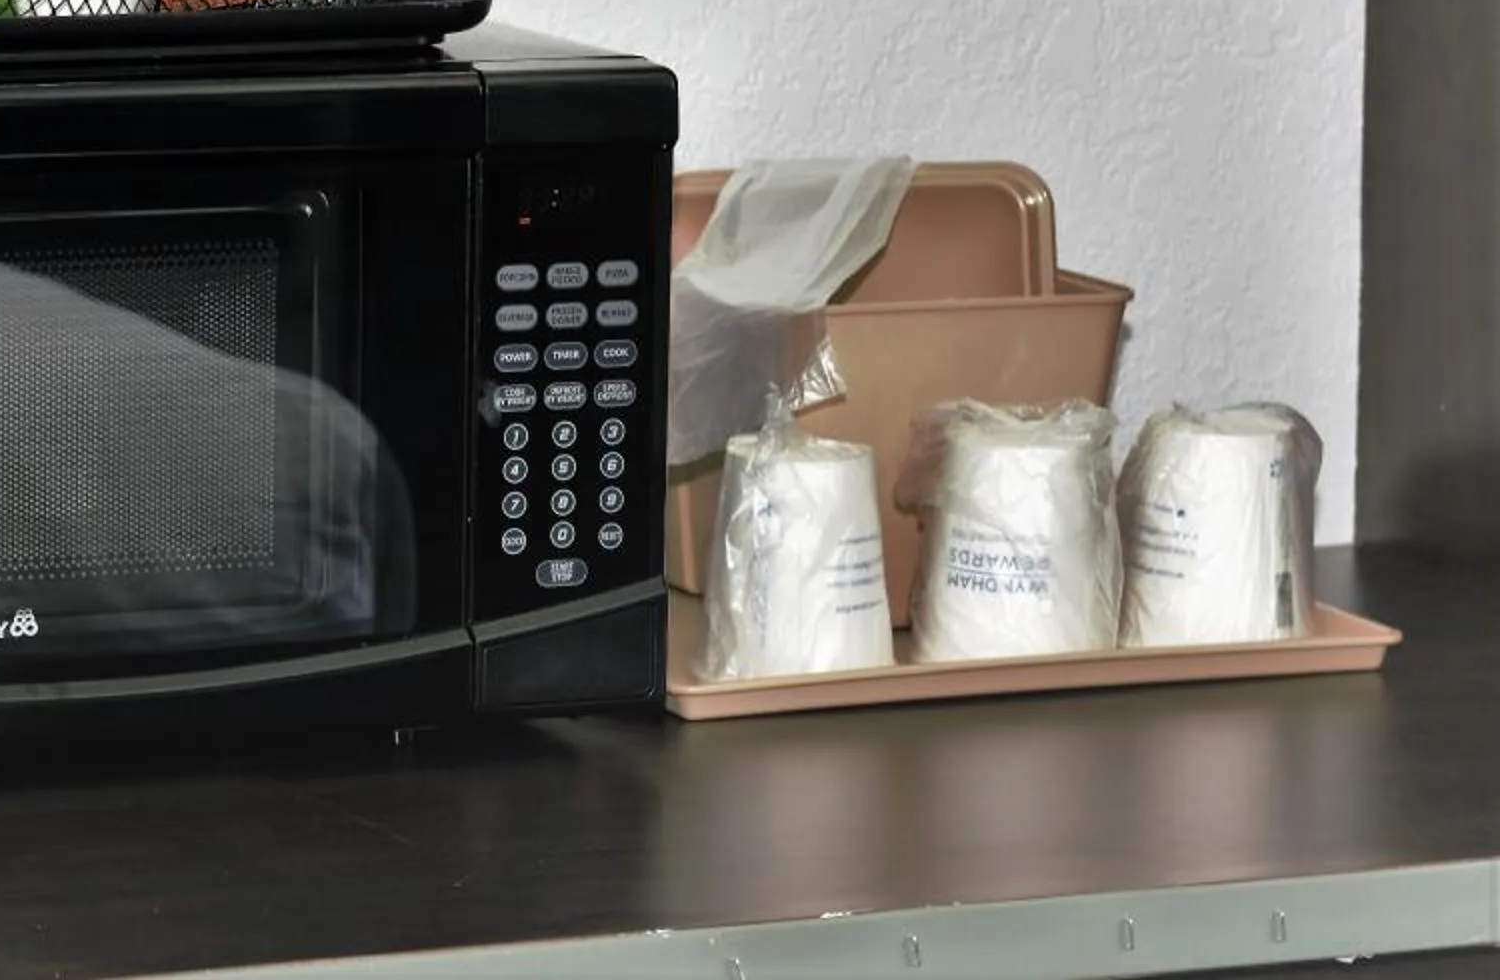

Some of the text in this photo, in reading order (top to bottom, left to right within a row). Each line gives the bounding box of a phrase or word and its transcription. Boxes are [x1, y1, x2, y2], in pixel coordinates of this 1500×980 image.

[500, 351, 532, 362] POWER
[603, 348, 629, 357] COOK
[559, 427, 571, 441] 2
[607, 425, 619, 439] 3
[510, 463, 520, 476] 4
[558, 461, 569, 474] 5
[607, 459, 618, 471] 6
[511, 499, 521, 511] 7
[558, 495, 569, 509] 8
[606, 492, 617, 506] 9
[557, 528, 568, 541] 0
